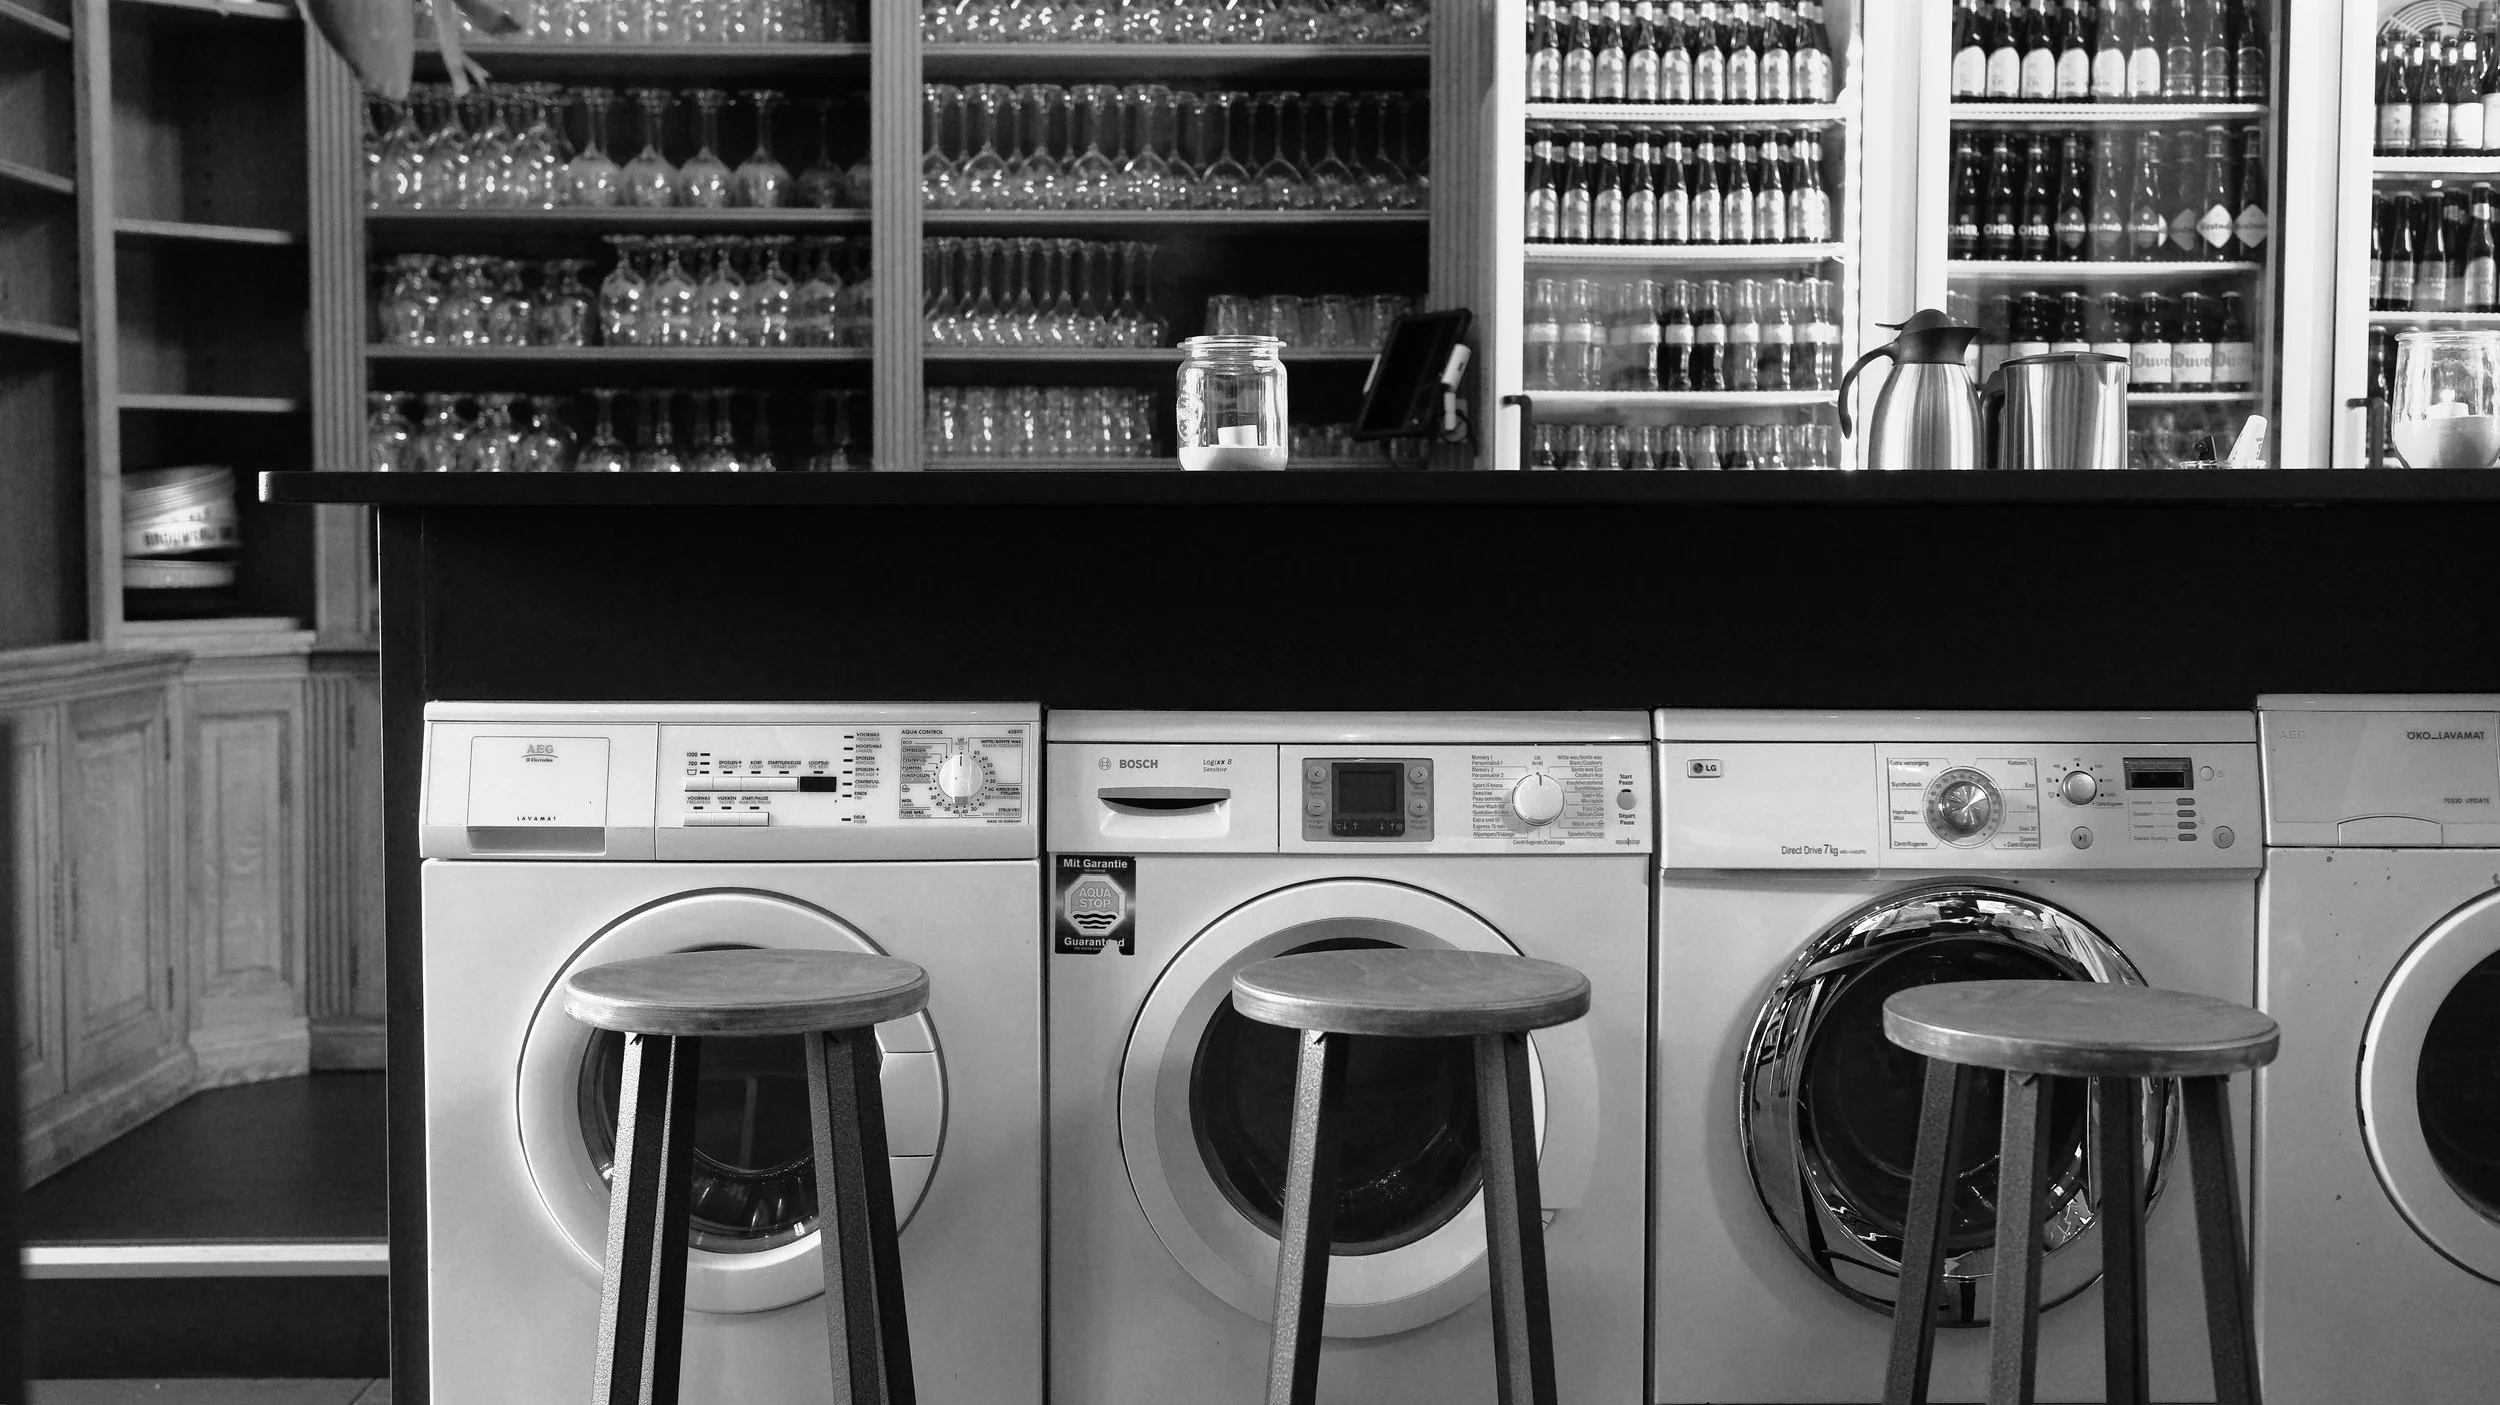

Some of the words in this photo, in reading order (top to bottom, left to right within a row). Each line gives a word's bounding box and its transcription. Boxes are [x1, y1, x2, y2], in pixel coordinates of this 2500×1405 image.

[2280, 730, 2305, 739] AEG
[526, 744, 554, 753] AEG
[1119, 759, 1158, 768] BOSCH
[1781, 846, 1802, 854] Direct
[1804, 846, 1822, 854] Drive
[1063, 858, 1080, 867] Mit
[1083, 859, 1127, 868] Garantie
[1079, 888, 1111, 898] AQUA
[1079, 899, 1111, 907] STOP
[1064, 937, 1124, 946] Guarantd
